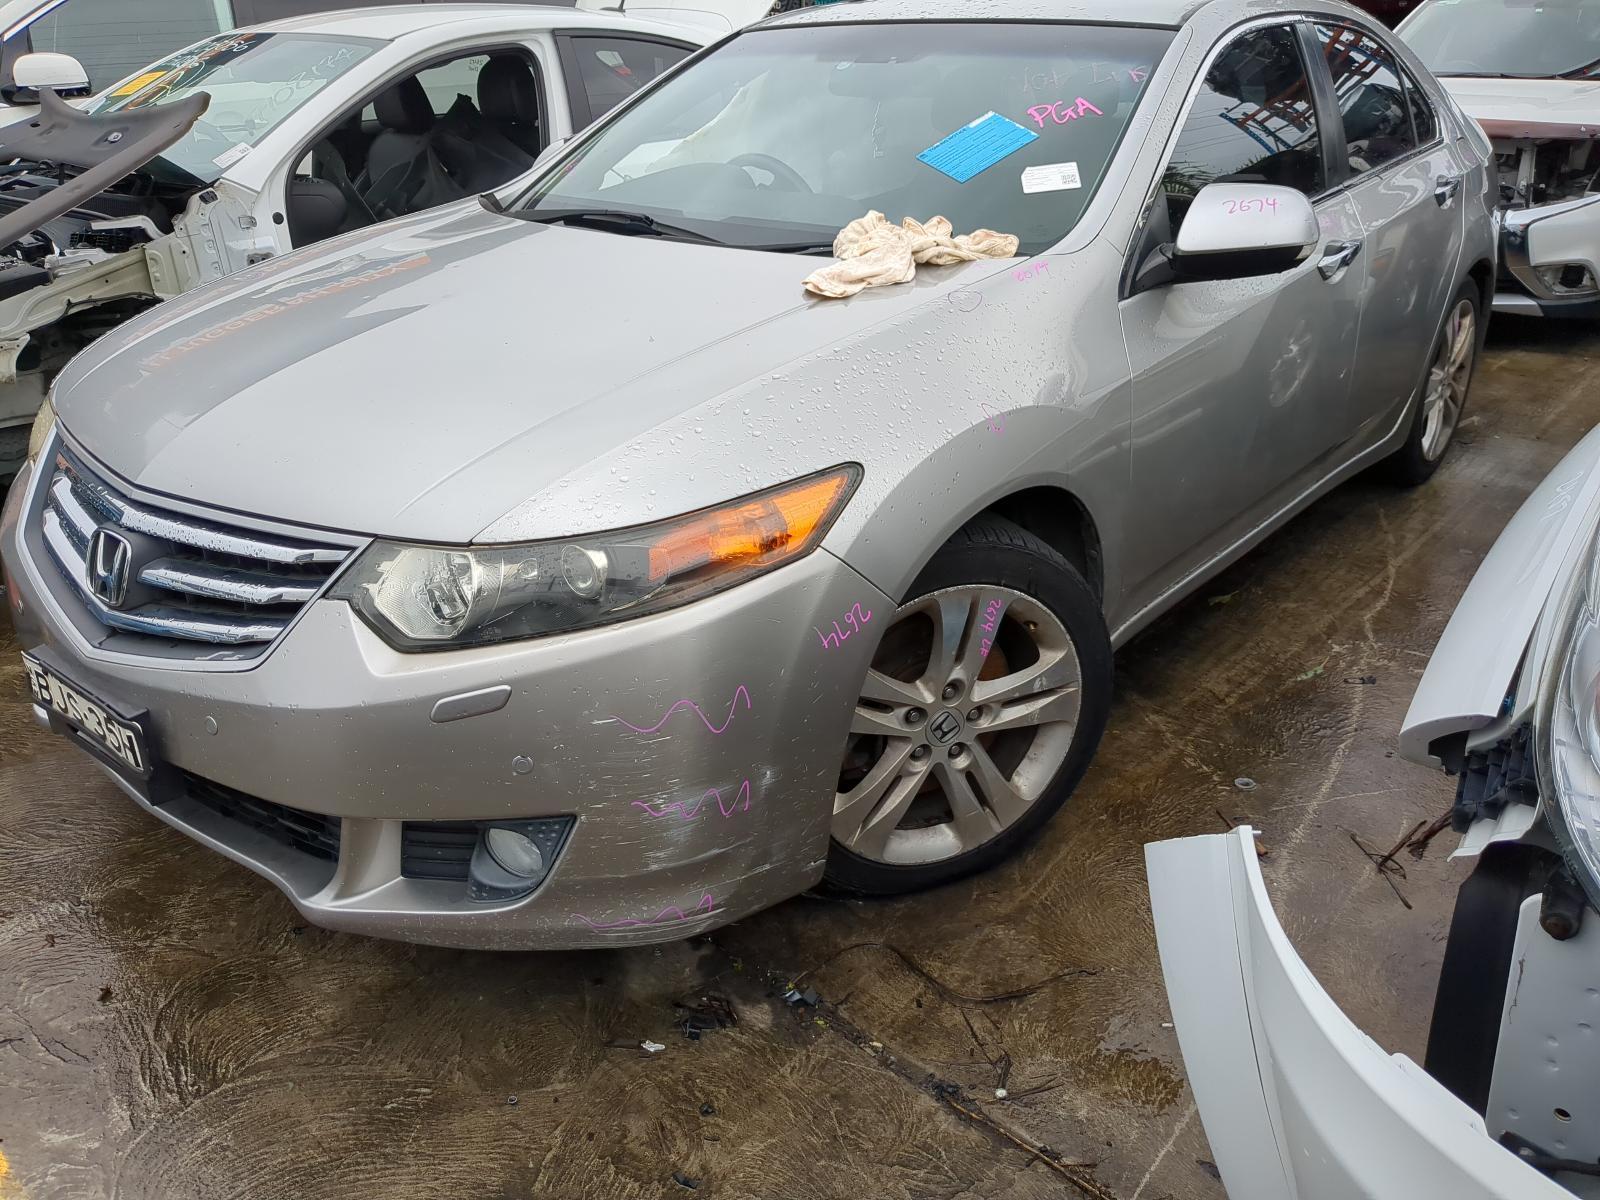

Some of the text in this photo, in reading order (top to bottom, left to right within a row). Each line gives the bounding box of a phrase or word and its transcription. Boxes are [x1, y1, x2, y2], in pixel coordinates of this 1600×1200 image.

[1026, 97, 1104, 129] PGA
[1222, 198, 1278, 216] 2674
[814, 602, 872, 649] 2674
[980, 598, 1002, 633] 2674
